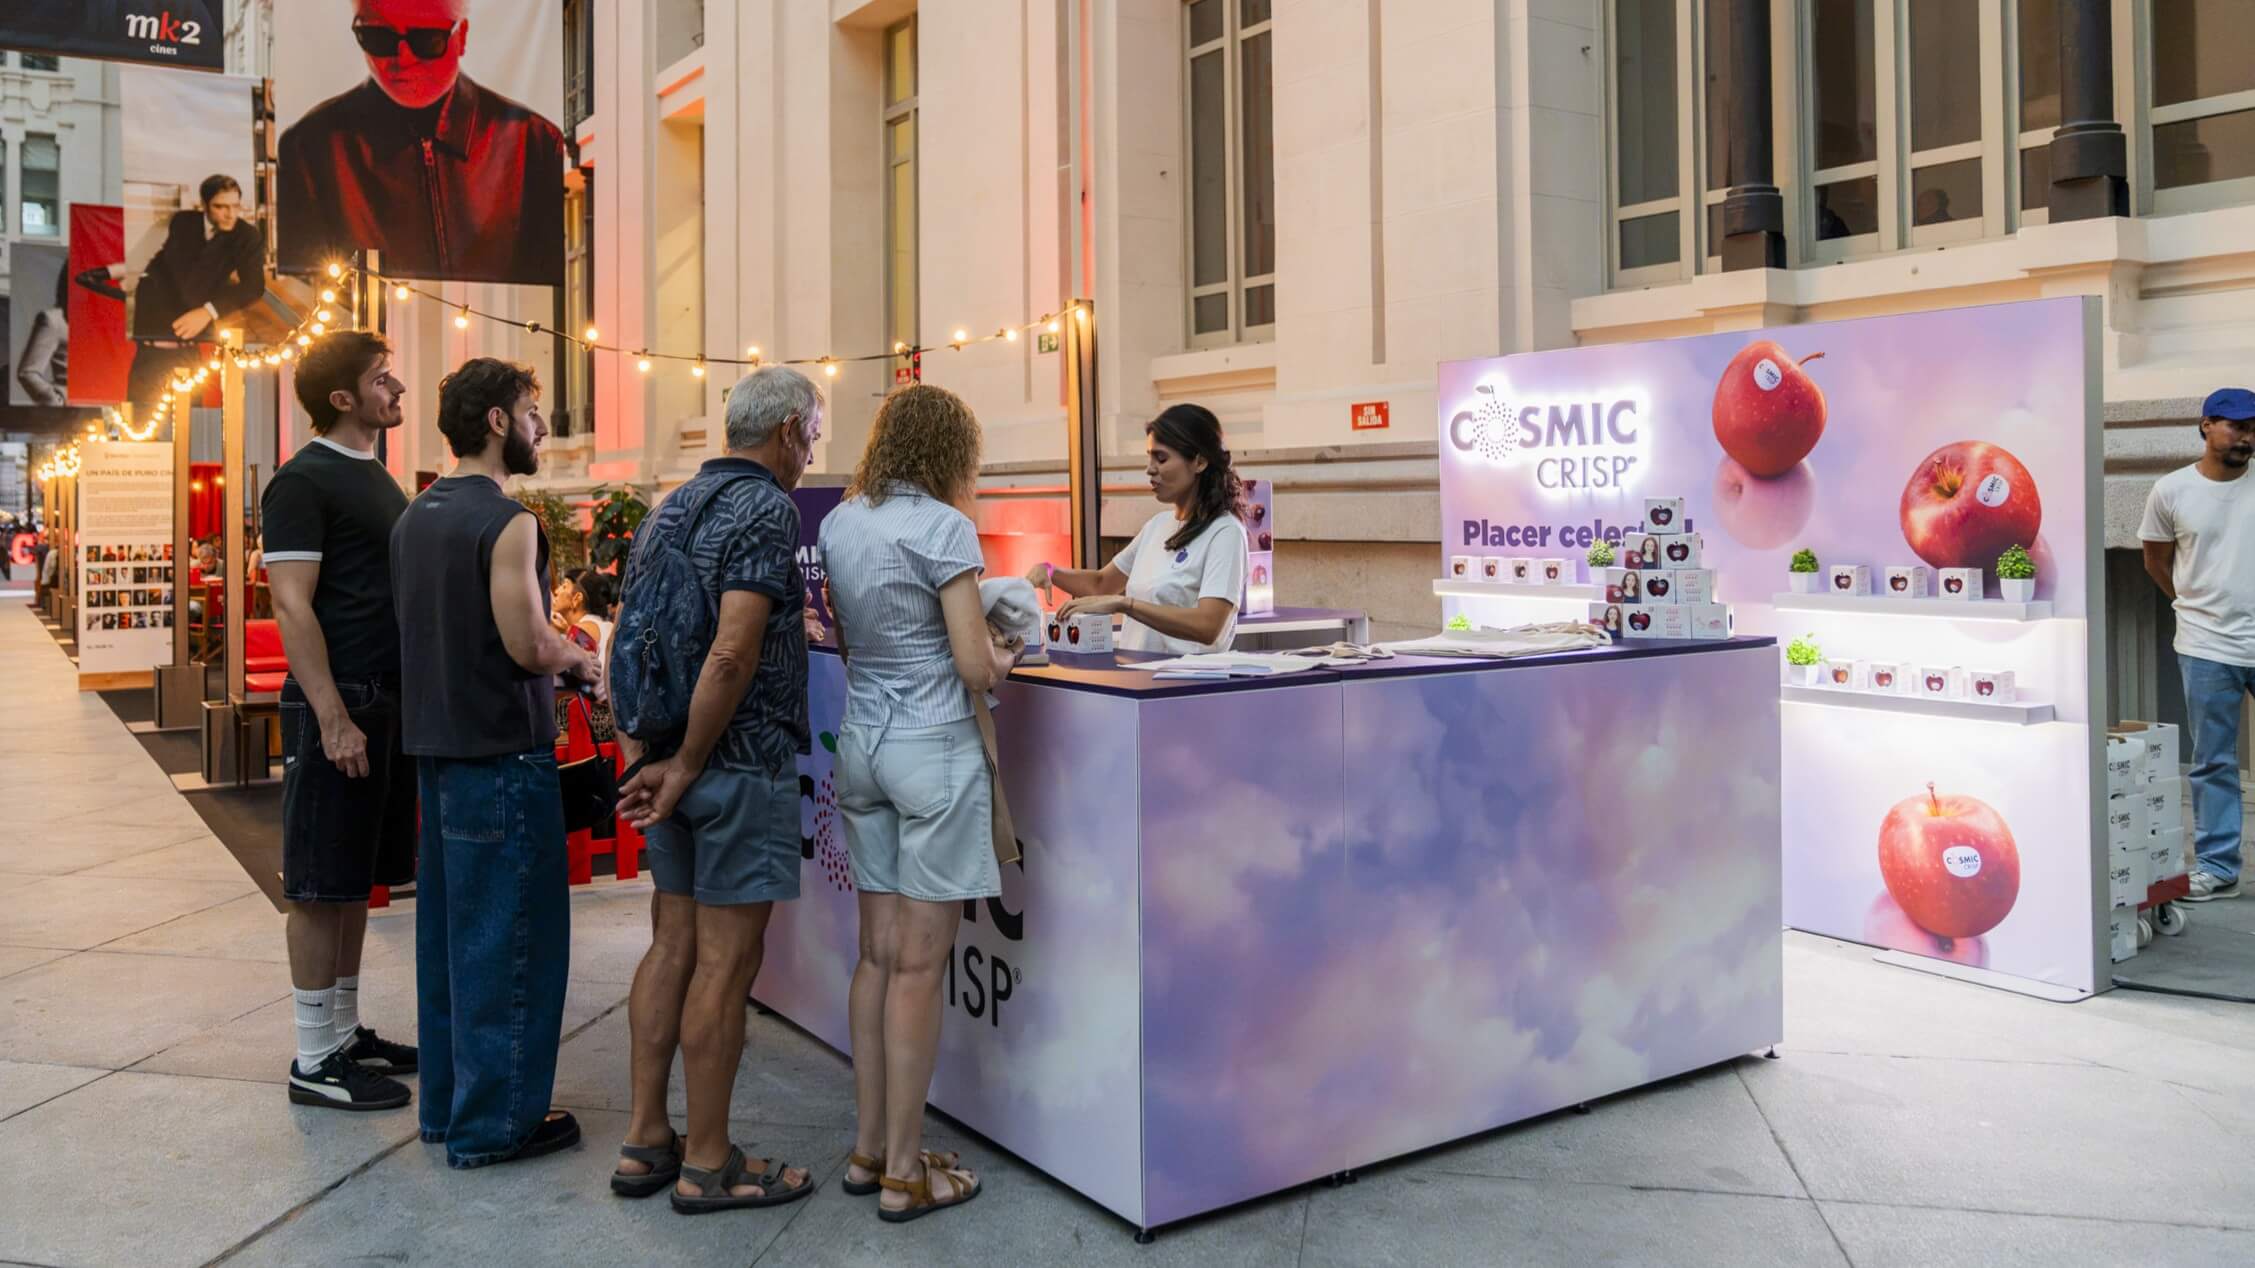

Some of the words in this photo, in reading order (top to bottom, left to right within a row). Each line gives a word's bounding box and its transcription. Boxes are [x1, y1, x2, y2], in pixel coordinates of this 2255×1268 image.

[125, 10, 201, 46] mk2
[149, 44, 178, 56] cines
[1450, 385, 1638, 460] COSMIC
[1463, 519, 1551, 547] Placer
